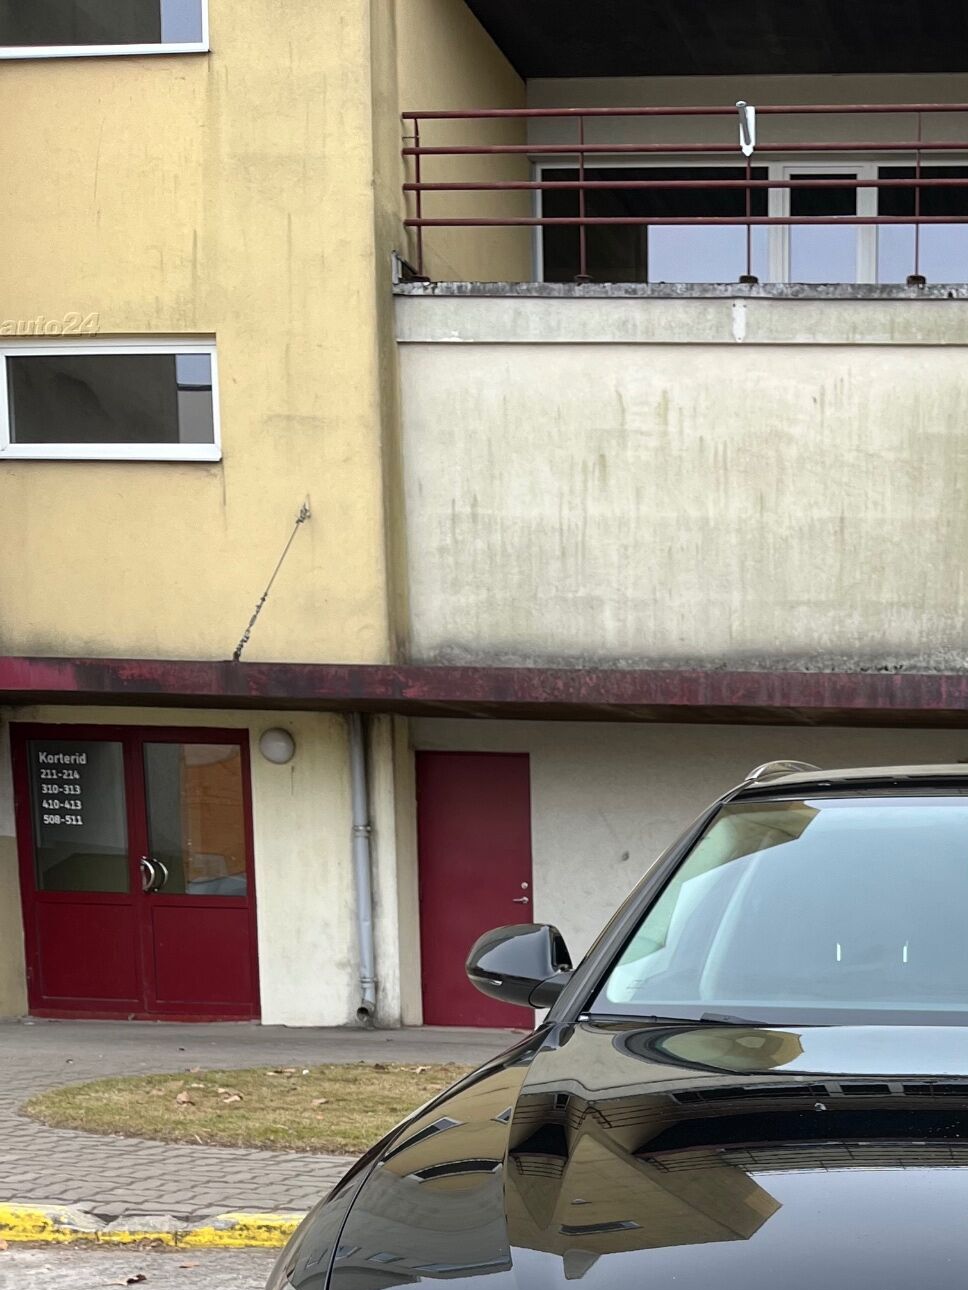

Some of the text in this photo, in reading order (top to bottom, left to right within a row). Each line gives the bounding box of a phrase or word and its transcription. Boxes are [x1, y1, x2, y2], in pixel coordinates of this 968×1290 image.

[39, 752, 87, 764] Korterid
[40, 769, 80, 779] 211-214
[41, 784, 81, 794] 310-313
[42, 800, 82, 809] 410-413
[43, 814, 83, 825] 508-511
